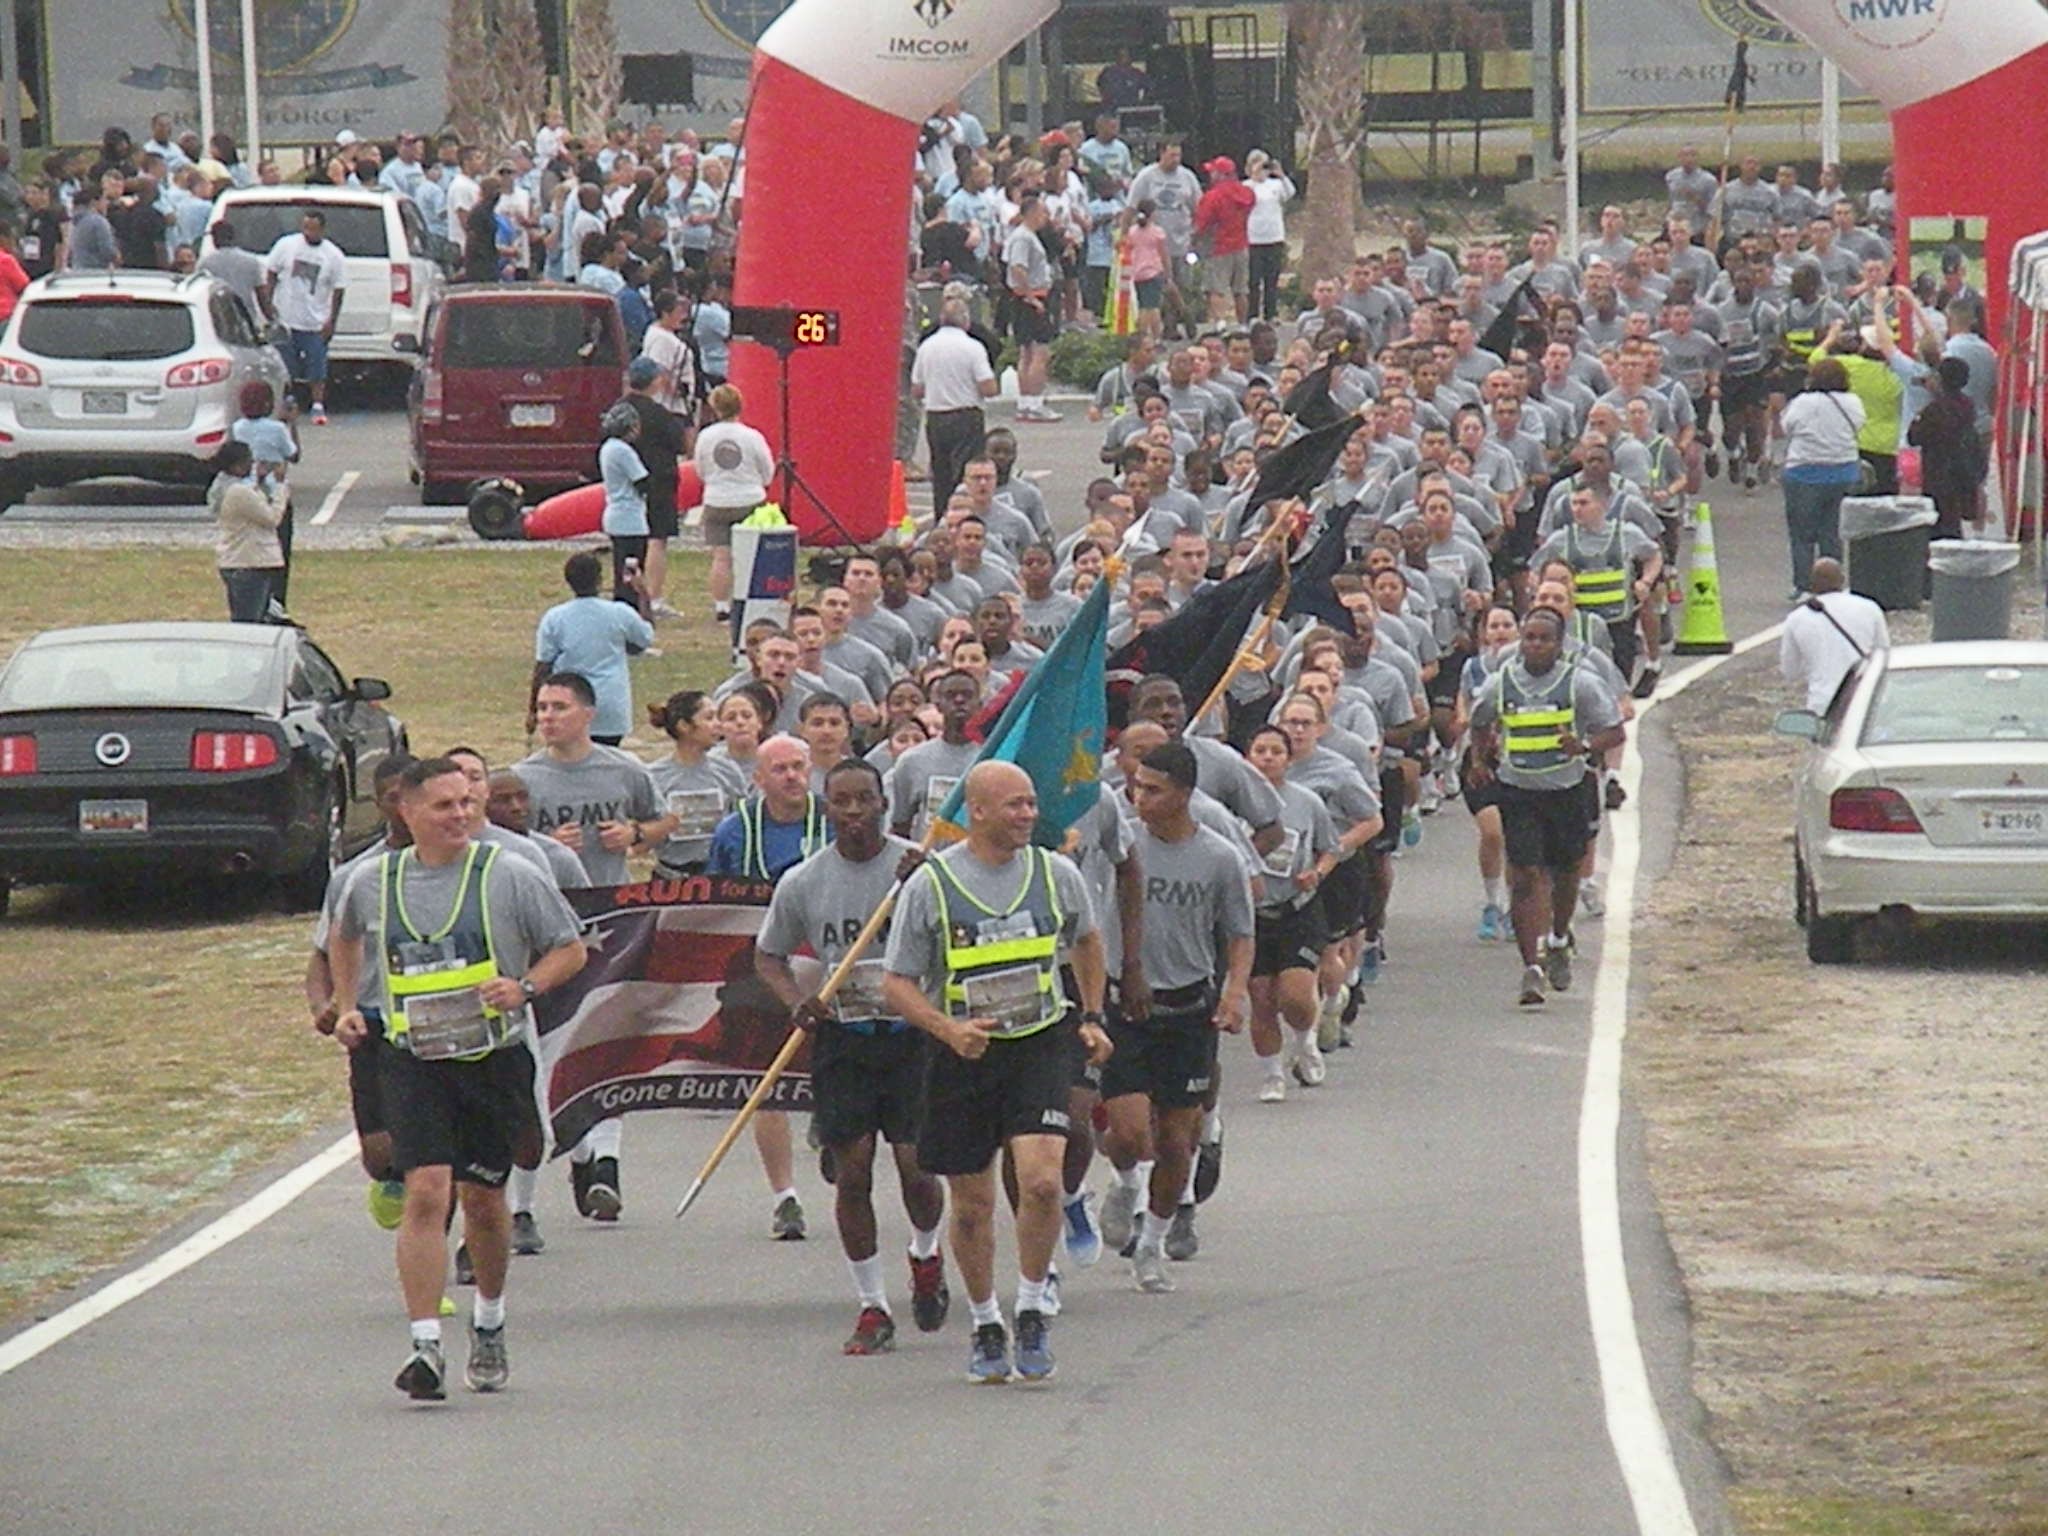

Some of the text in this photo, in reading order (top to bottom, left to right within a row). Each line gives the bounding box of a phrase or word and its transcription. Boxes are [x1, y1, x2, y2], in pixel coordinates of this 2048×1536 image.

[1849, 0, 1935, 20] MWR
[889, 38, 969, 54] IMCOM
[797, 313, 825, 342] 26
[537, 801, 619, 832] ARMY
[720, 880, 748, 898] for
[1147, 876, 1218, 906] RMY
[678, 1077, 728, 1100] But
